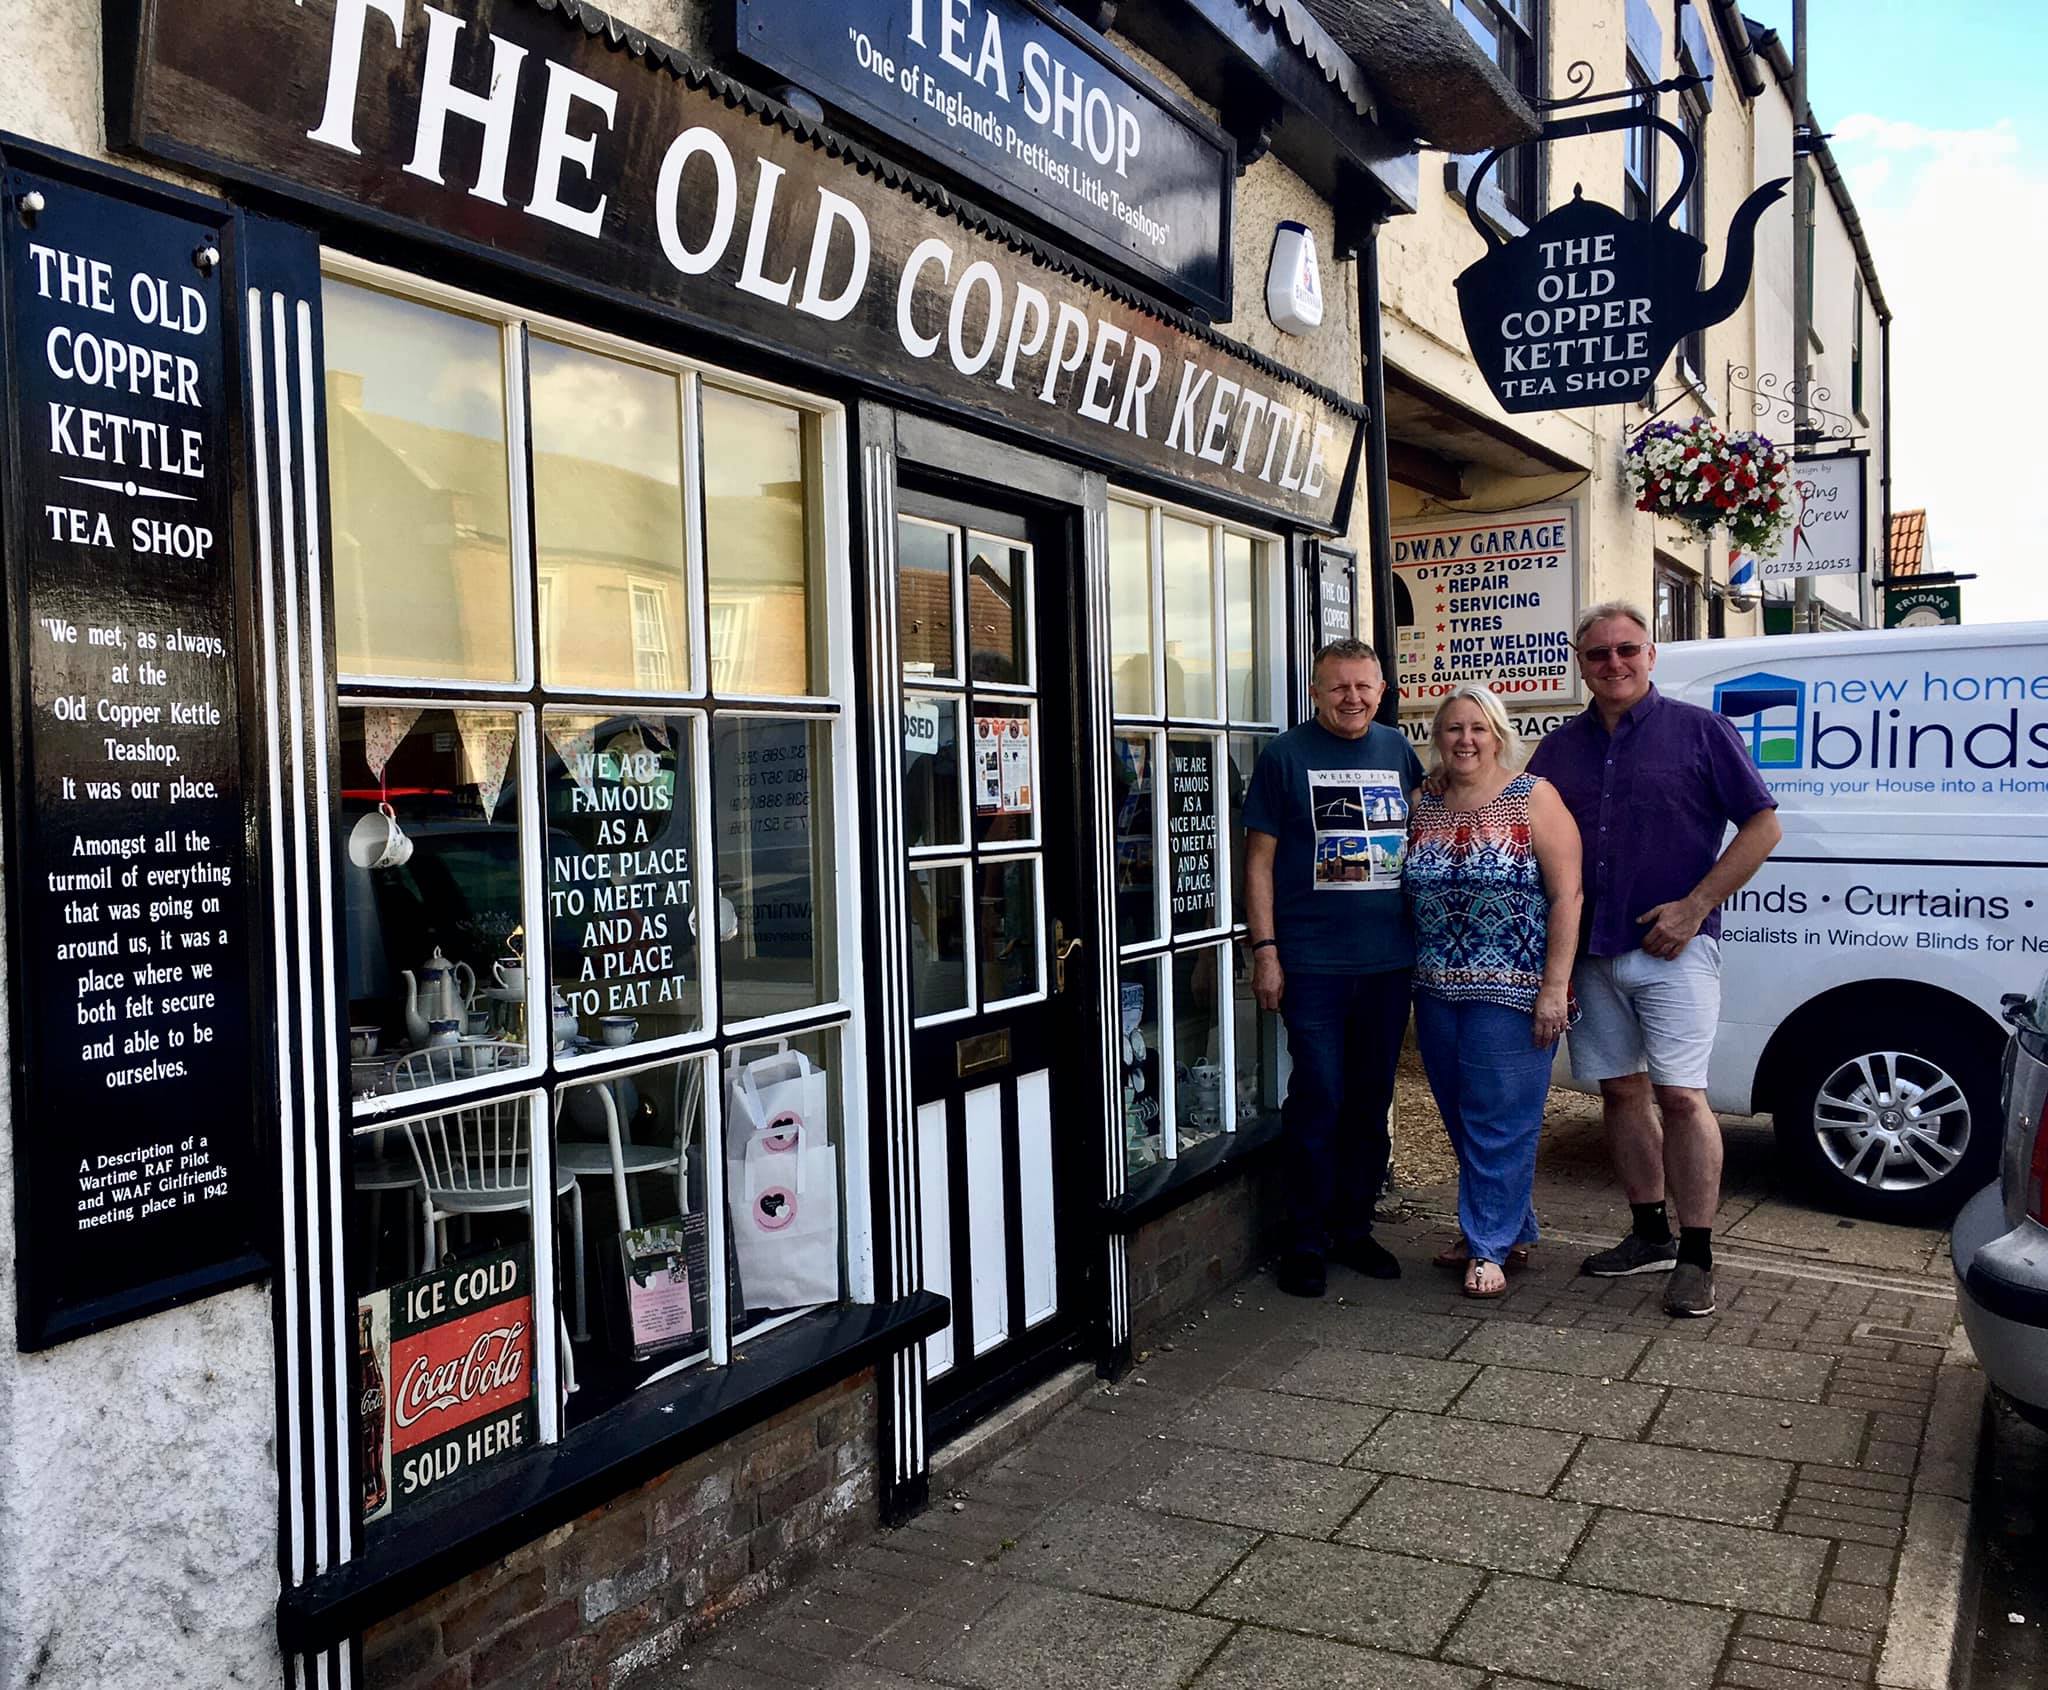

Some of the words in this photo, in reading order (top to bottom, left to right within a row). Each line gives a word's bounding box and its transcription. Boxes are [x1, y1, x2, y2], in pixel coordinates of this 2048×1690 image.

[907, 0, 1011, 103] TEA
[1022, 41, 1141, 179] SHOP
[849, 26, 896, 84] "One
[900, 65, 921, 98] of
[922, 72, 1004, 148] England's
[1006, 122, 1071, 186] Prettiest
[1073, 167, 1109, 211] Little
[1110, 190, 1171, 246] Teashops"
[294, 0, 619, 238] THE
[655, 126, 871, 321] OLD
[896, 238, 1162, 440] COPPER
[1163, 359, 1335, 499] KETTLE
[1539, 234, 1616, 270] THE
[29, 243, 115, 314] THE
[130, 272, 207, 335] OLD
[1537, 269, 1616, 302] OLD
[1501, 298, 1653, 340] COPPER
[46, 326, 202, 407] COPPER
[1503, 332, 1649, 373] KETTLE
[1500, 376, 1557, 398] TEA
[1566, 367, 1651, 392] SHOP
[48, 401, 204, 478] KETTLE
[45, 505, 115, 548] TEA
[131, 518, 213, 559] SHOP
[1802, 508, 1849, 528] Crew
[1471, 525, 1565, 555] GARAGE
[1417, 562, 1477, 580] 01733
[1483, 556, 1559, 573] 210212
[1765, 562, 1803, 575] 01733
[1806, 558, 1852, 571] 210151
[1321, 581, 1335, 601] THE
[1449, 575, 1509, 593] REPAIR
[1449, 592, 1540, 613] SERVICING
[1895, 593, 1950, 612] FRYDAYS
[1324, 607, 1349, 629] COPPER
[1450, 616, 1503, 634] TYRES
[41, 618, 77, 643] "We
[88, 626, 127, 650] met,
[137, 631, 157, 649] as
[166, 628, 226, 658] always,
[1450, 637, 1485, 654] MOT
[1491, 631, 1568, 650] WELDING
[111, 663, 129, 684] at
[139, 661, 167, 686] the
[1432, 669, 1493, 682] QUALITY
[1498, 665, 1567, 678] ASSURED
[1433, 655, 1445, 671] &
[1451, 648, 1569, 670] PREPARATION
[1488, 678, 1566, 694] QUOTE
[1813, 679, 1908, 703] new
[1924, 671, 2048, 701] home
[54, 696, 87, 721] Old
[97, 699, 161, 728] Copper
[170, 702, 221, 725] Kettle
[104, 737, 180, 767] Teashop.
[1811, 708, 2048, 770] blinds
[575, 754, 611, 779] WE
[618, 753, 662, 778] ARE
[1175, 757, 1188, 772] WE
[1190, 757, 1207, 772] ARE
[62, 776, 76, 800] It
[85, 782, 121, 800] was
[131, 782, 161, 799] our
[170, 775, 219, 804] place.
[571, 785, 669, 813] FAMOUS
[1174, 776, 1209, 793] FAMOUS
[1830, 781, 1869, 796] your
[1876, 778, 1936, 793] House
[1941, 778, 1976, 793] into
[1982, 781, 1993, 793] a
[1183, 796, 1194, 812] AS
[1195, 796, 1202, 812] A
[597, 819, 627, 846] AS
[634, 818, 649, 843] A
[1170, 816, 1189, 833] NICE
[1191, 815, 1216, 831] PLACE
[71, 835, 147, 860] Amongst
[155, 831, 177, 853] all
[185, 830, 211, 852] the
[1182, 835, 1205, 852] MEET
[1206, 834, 1216, 849] AT
[48, 866, 112, 892] turmoil
[121, 865, 139, 888] of
[147, 862, 232, 889] everything
[555, 853, 611, 883] NICE
[619, 848, 688, 878] PLACE
[1178, 855, 1196, 872] AND
[1198, 854, 1209, 871] AS
[1177, 877, 1183, 893] A
[1185, 873, 1211, 892] PLACE
[64, 901, 99, 924] that
[108, 902, 141, 921] was
[150, 896, 193, 923] going
[202, 897, 220, 913] on
[551, 889, 584, 919] TO
[593, 884, 657, 914] MEET
[663, 879, 691, 906] AT
[1172, 898, 1185, 914] TO
[1187, 894, 1202, 911] EAT
[1204, 892, 1215, 908] AT
[1845, 885, 2010, 919] Curtains
[57, 932, 119, 960] around
[129, 936, 151, 955] us,
[160, 930, 172, 951] it
[180, 930, 210, 948] was
[218, 929, 228, 945] a
[582, 919, 632, 949] AND
[639, 913, 668, 941] AS
[1805, 929, 1820, 945] in
[1828, 930, 1909, 947] Window
[1916, 932, 1979, 950] Blinds
[1986, 934, 2015, 951] for
[579, 956, 596, 984] A
[603, 945, 674, 980] PLACE
[78, 969, 124, 998] place
[133, 963, 183, 986] where
[191, 963, 213, 980] we
[77, 999, 116, 1025] both
[126, 995, 153, 1019] felt
[162, 992, 215, 1015] secure
[566, 988, 600, 1019] TO
[608, 980, 651, 1011] EAT
[658, 975, 686, 1003] AT
[82, 1035, 115, 1061] and
[124, 1030, 160, 1054] able
[168, 1029, 184, 1048] to
[193, 1023, 213, 1044] be
[106, 1059, 188, 1088] ourselves.
[79, 1159, 90, 1173] A
[97, 1143, 174, 1169] Description
[181, 1136, 194, 1151] of
[200, 1136, 208, 1147] a
[79, 1169, 138, 1191] Wartime
[145, 1159, 174, 1178] RAF
[180, 1152, 209, 1169] Pilot
[78, 1192, 104, 1211] and
[111, 1182, 152, 1203] WAAF
[159, 1165, 228, 1192] Girlfriend's
[78, 1206, 134, 1230] meeting
[141, 1197, 177, 1218] place
[183, 1191, 195, 1205] in
[203, 1182, 228, 1200] 1942
[407, 1280, 446, 1324] ICE
[454, 1259, 517, 1307] COLD
[402, 1441, 461, 1494] SOLD
[467, 1412, 523, 1465] HERE
